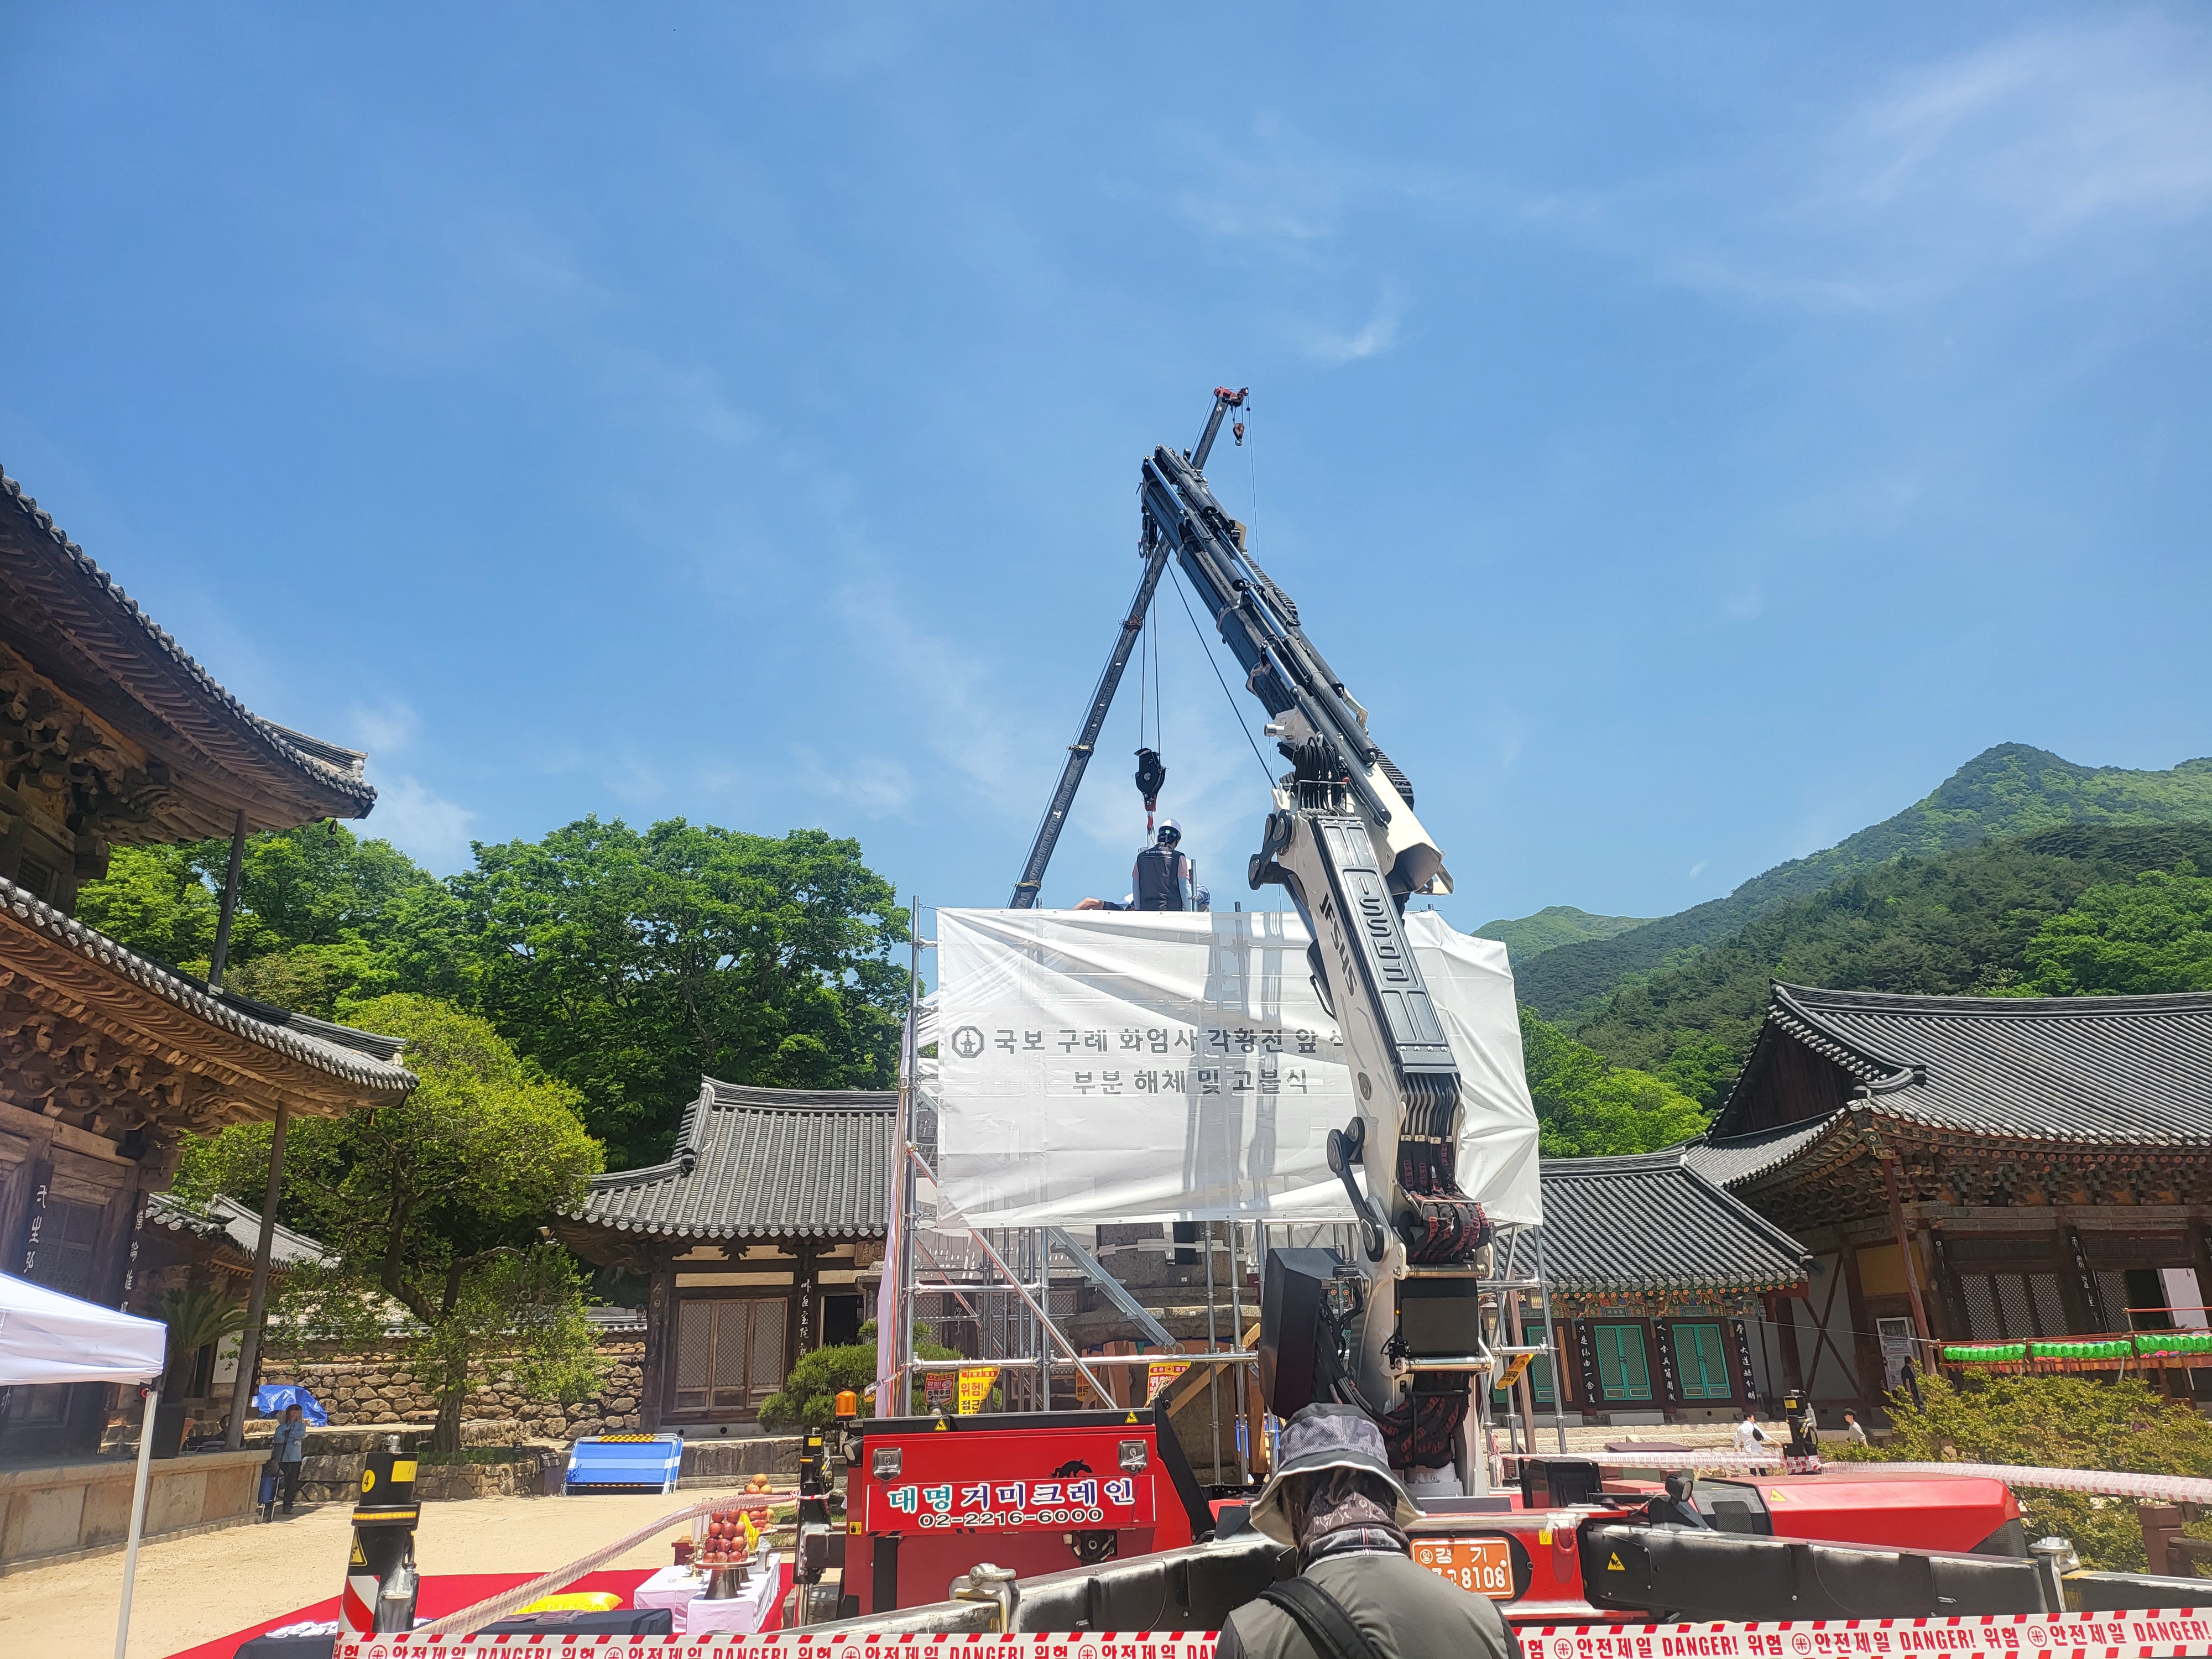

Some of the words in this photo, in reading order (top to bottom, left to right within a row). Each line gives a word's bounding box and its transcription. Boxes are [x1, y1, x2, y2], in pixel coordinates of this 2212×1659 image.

[994, 1029, 1045, 1055] 국보
[1057, 1029, 1108, 1053] 구례
[1119, 1027, 1198, 1053] 화엄사
[1208, 1027, 1284, 1053] 각황전
[1295, 1029, 1319, 1053] 앞
[1072, 1071, 1123, 1094] 부분
[1134, 1069, 1186, 1094] 해체
[1197, 1069, 1221, 1095] 및
[1232, 1069, 1308, 1094] 고불식
[961, 1382, 984, 1397] 위험!
[961, 1400, 984, 1411] 접근
[364, 1474, 370, 1488] 4
[918, 1508, 1104, 1528] 02-2216-6000
[1577, 1637, 1653, 1659] 안전제일
[1662, 1635, 1740, 1657] DANGER!
[1747, 1634, 1784, 1656] 위험
[1814, 1630, 1892, 1655] 안전제일
[1898, 1628, 1976, 1651] DANGER!
[1984, 1626, 2021, 1650] 위험
[2049, 1622, 2127, 1647] 안전제일
[2132, 1620, 2210, 1643] DANGER!
